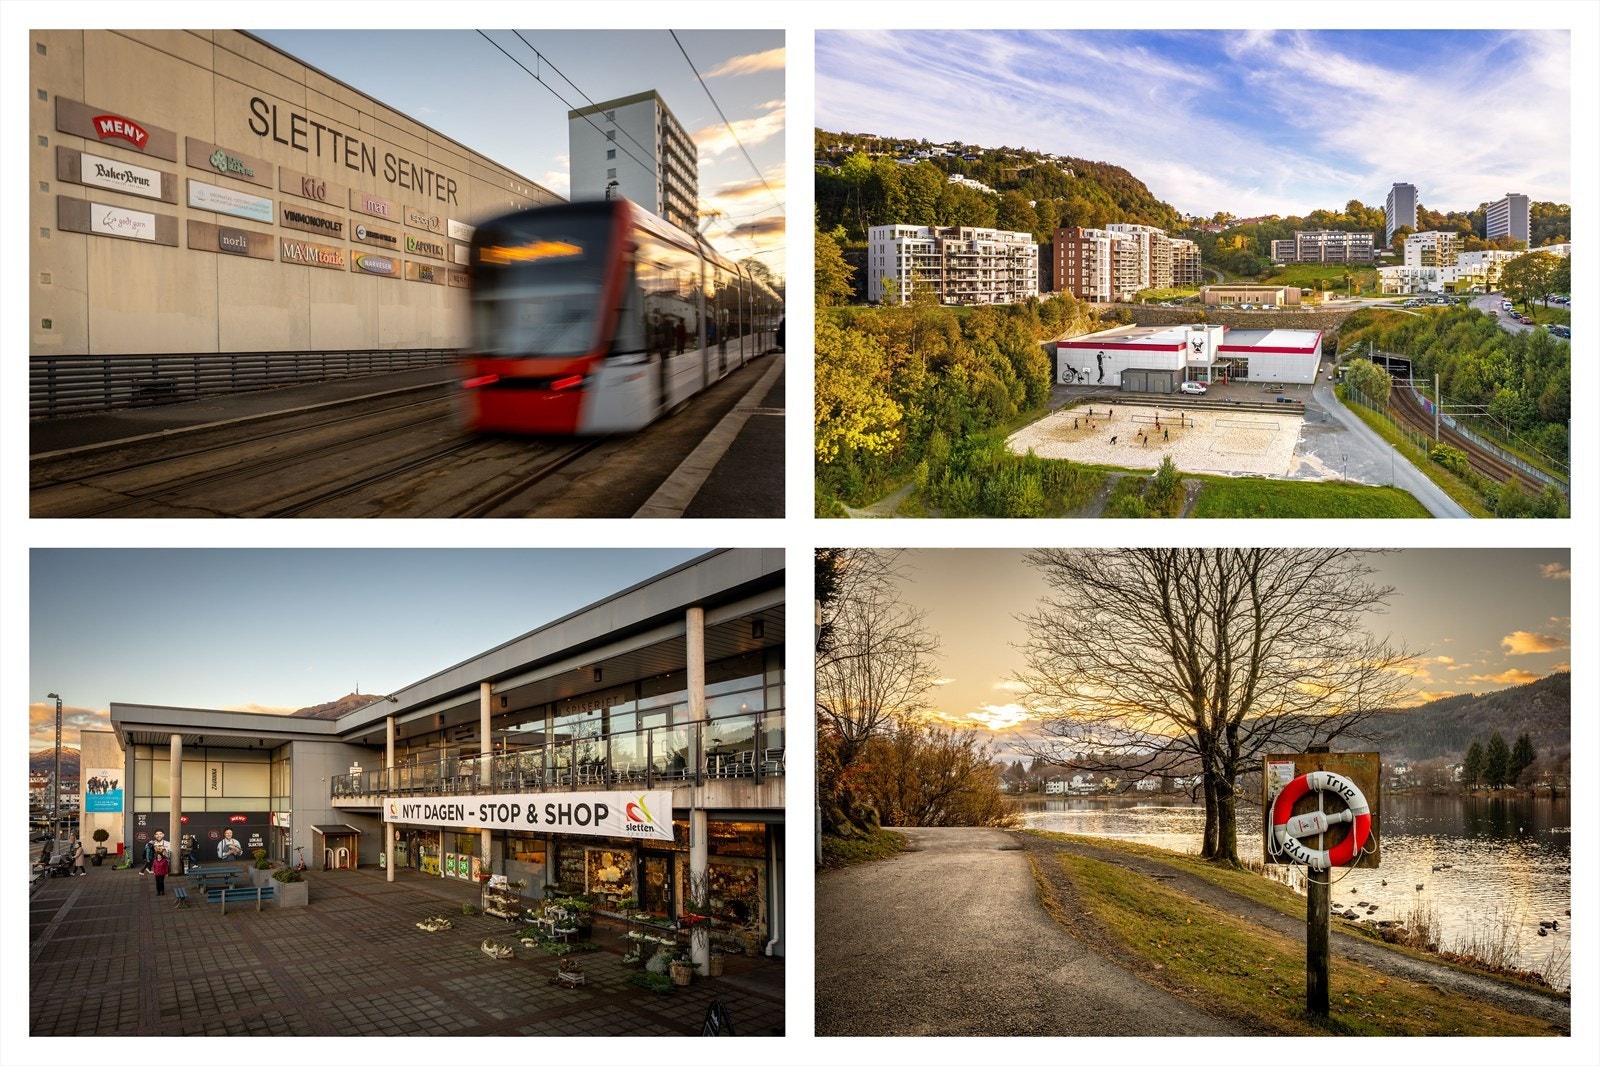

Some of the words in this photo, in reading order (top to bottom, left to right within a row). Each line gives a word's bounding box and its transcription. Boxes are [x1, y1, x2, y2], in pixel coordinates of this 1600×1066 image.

[100, 119, 144, 142] MENY
[248, 97, 376, 177] SLETTEN
[384, 152, 458, 206] SENTER
[95, 164, 150, 186] BakerBrun
[301, 176, 326, 200] Kid
[284, 210, 343, 232] VINMONOPOLET
[223, 235, 246, 248] norli
[364, 260, 392, 270] NARVESEN
[566, 696, 618, 715] SPISERIET
[1326, 774, 1356, 800] Tryg
[402, 804, 421, 819] NYT
[424, 804, 464, 821] DAGEN
[479, 803, 521, 823] STOP
[526, 803, 538, 824] &
[545, 802, 609, 827] SHOP
[626, 823, 654, 832] sletten
[1284, 838, 1311, 865] Tryg
